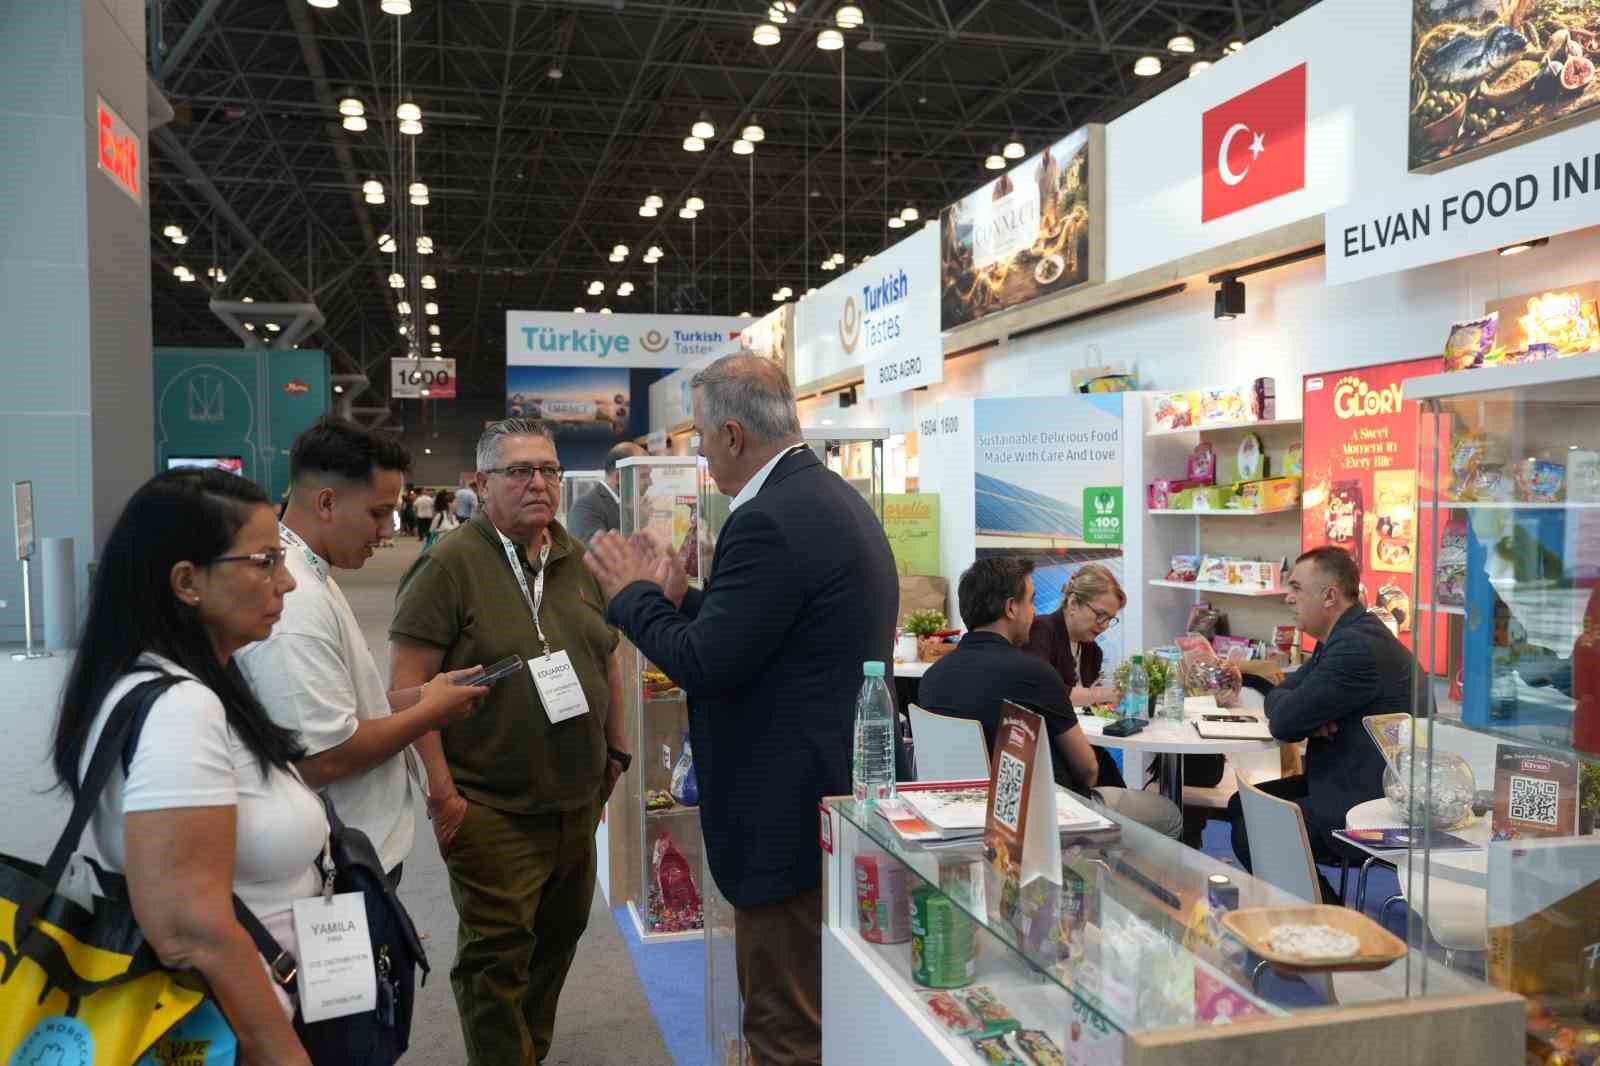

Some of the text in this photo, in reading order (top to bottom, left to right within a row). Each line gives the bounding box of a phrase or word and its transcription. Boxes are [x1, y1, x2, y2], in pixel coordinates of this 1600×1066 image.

[98, 106, 139, 194] Exit
[1344, 151, 1600, 258] ELVAN FOOD IN
[863, 268, 908, 313] Turkish
[673, 330, 722, 343] Turkish
[863, 314, 901, 347] Tastes
[521, 327, 630, 358] Türkiye
[398, 369, 449, 386] 1600
[879, 356, 921, 384] BOZS AGRO
[1333, 383, 1404, 420] GLORY
[920, 415, 959, 437] 1604 1600
[1359, 426, 1389, 441] Sweet
[978, 428, 1119, 447] Sustainable Delicious Food
[984, 448, 1116, 464] Made With Care And Love
[1343, 441, 1383, 455] Moment
[1344, 456, 1370, 471] Every
[537, 663, 570, 679] EDUARDO
[311, 920, 357, 936] YAMILA
